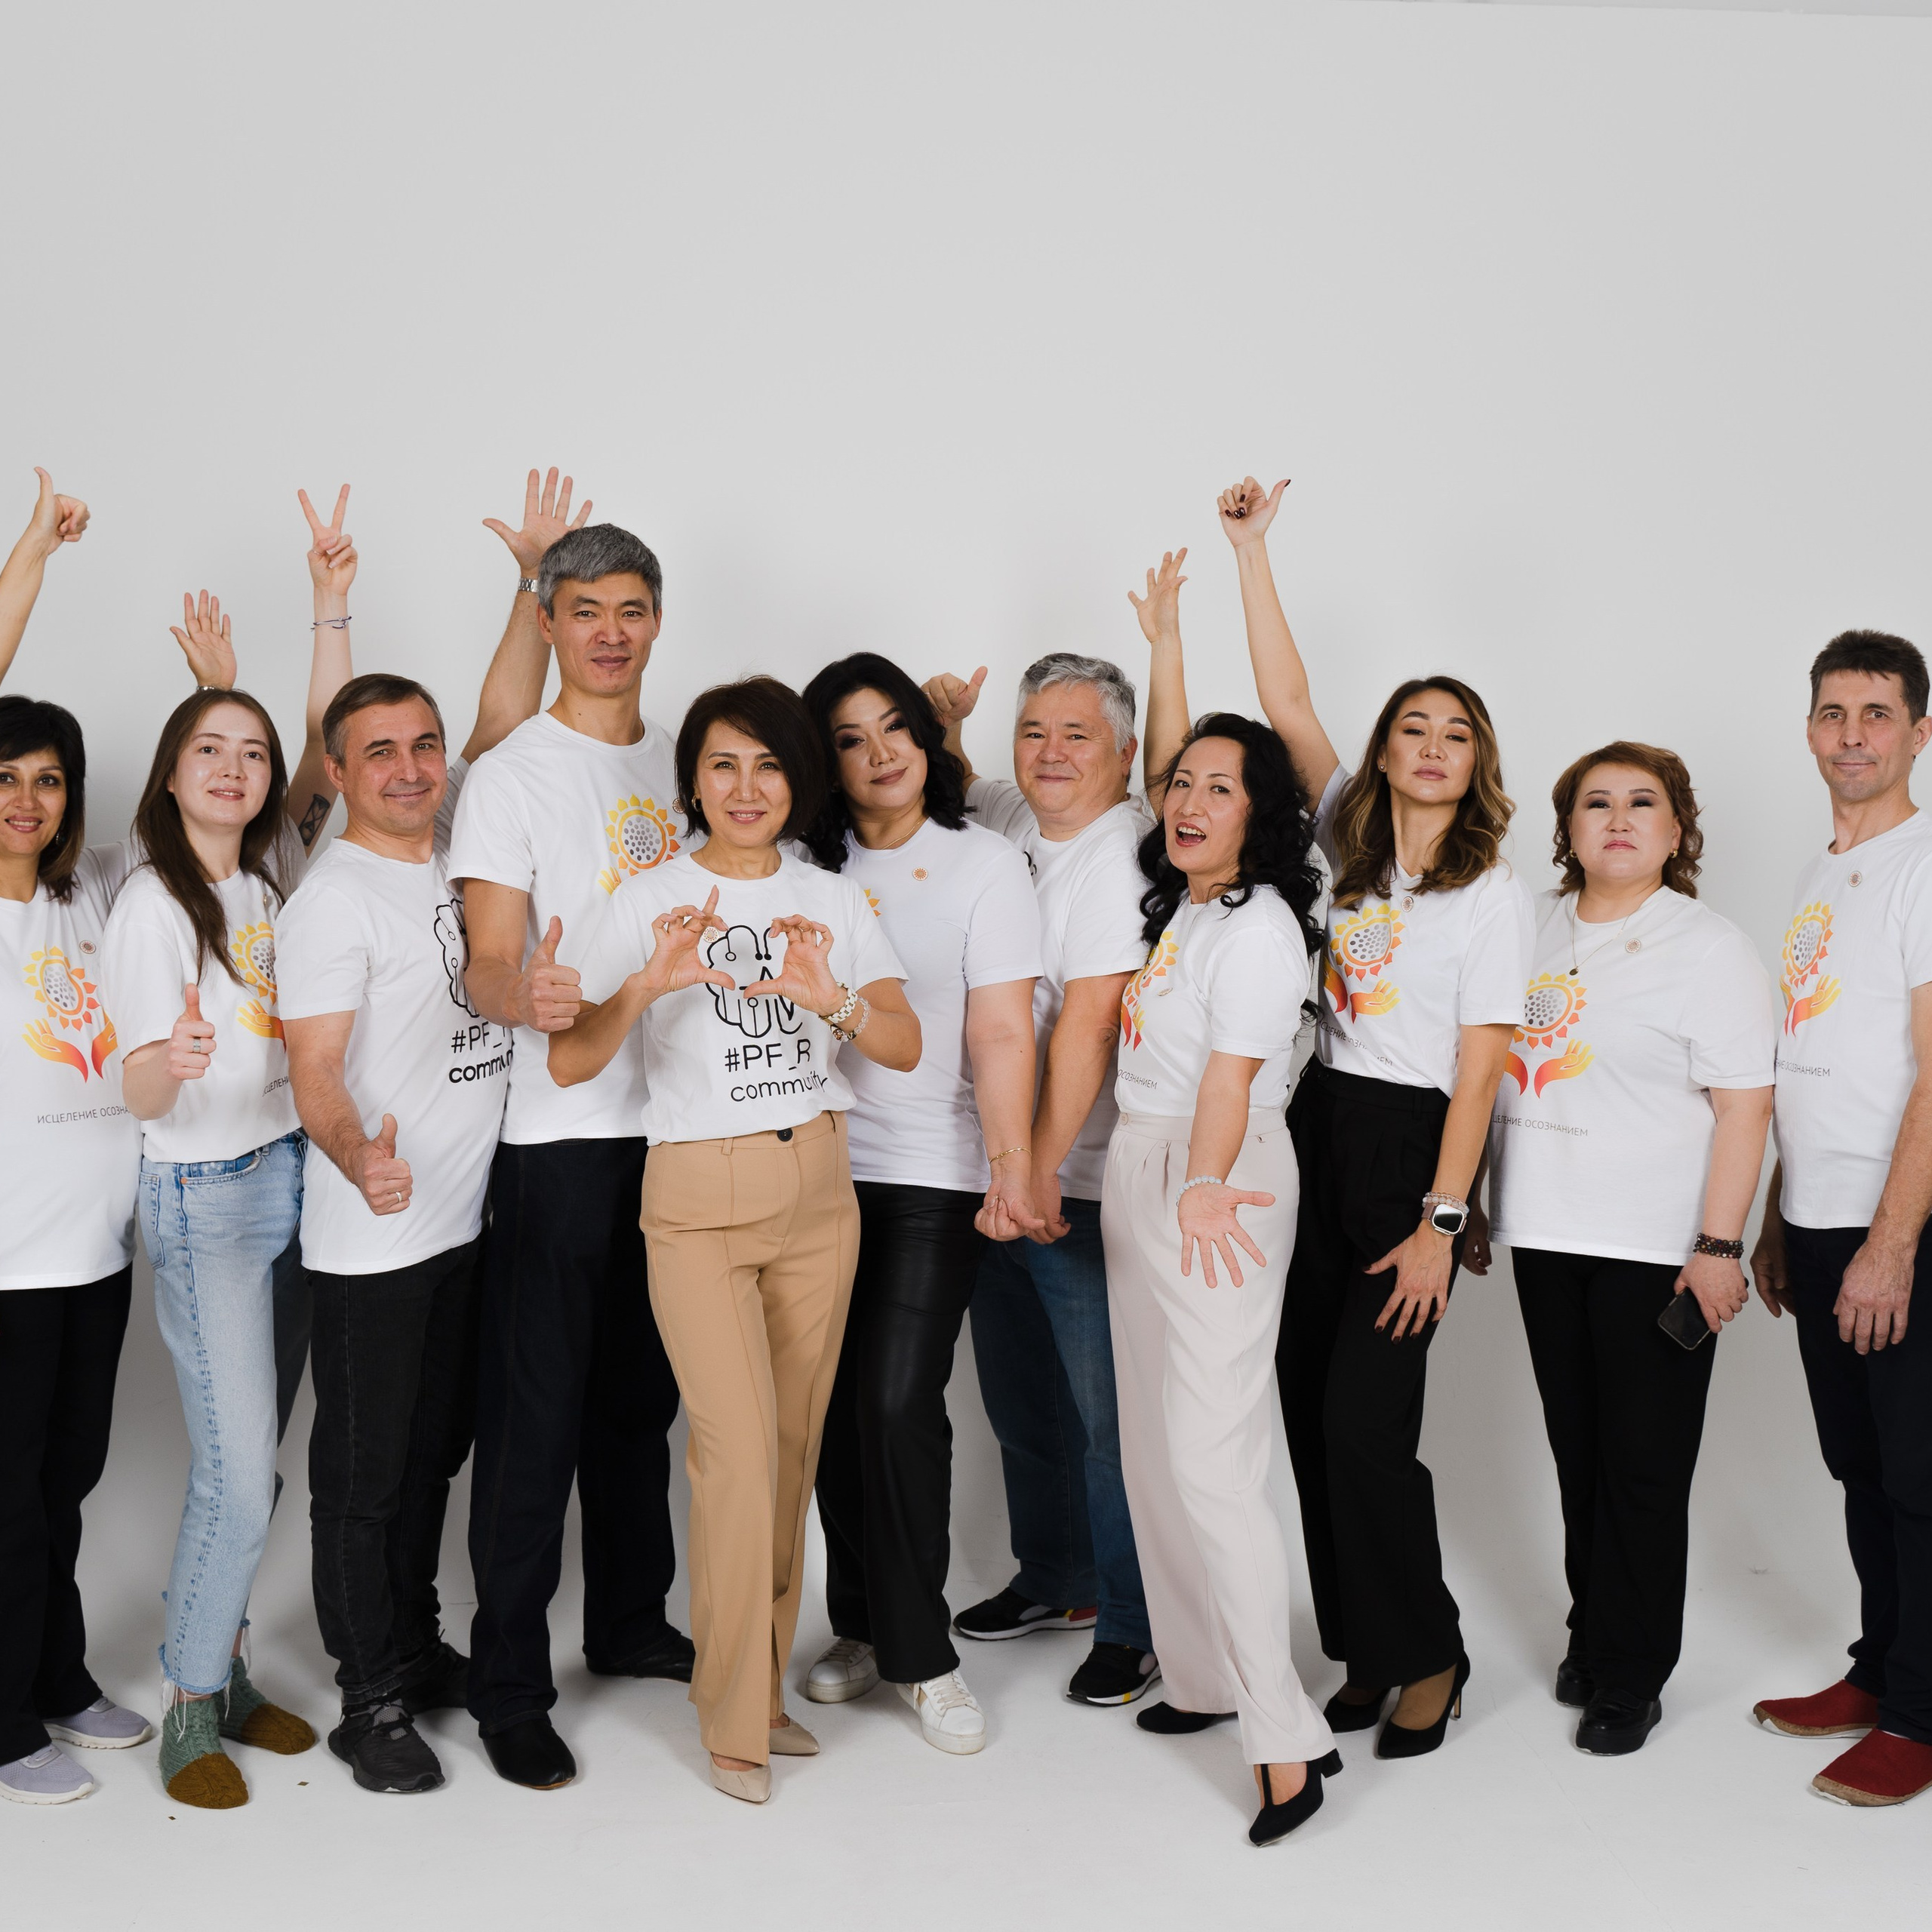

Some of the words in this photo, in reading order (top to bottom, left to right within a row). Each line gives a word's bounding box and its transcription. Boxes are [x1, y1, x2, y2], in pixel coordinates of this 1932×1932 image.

[724, 1038, 811, 1072] #PF_R
[731, 1070, 828, 1102] community
[1117, 1069, 1158, 1090] ОСОЗНАНИЕМ
[37, 1109, 98, 1124] ИСЦЕЛЕНИЕ
[1524, 1118, 1589, 1137] ОСОЗНАНИЕМ
